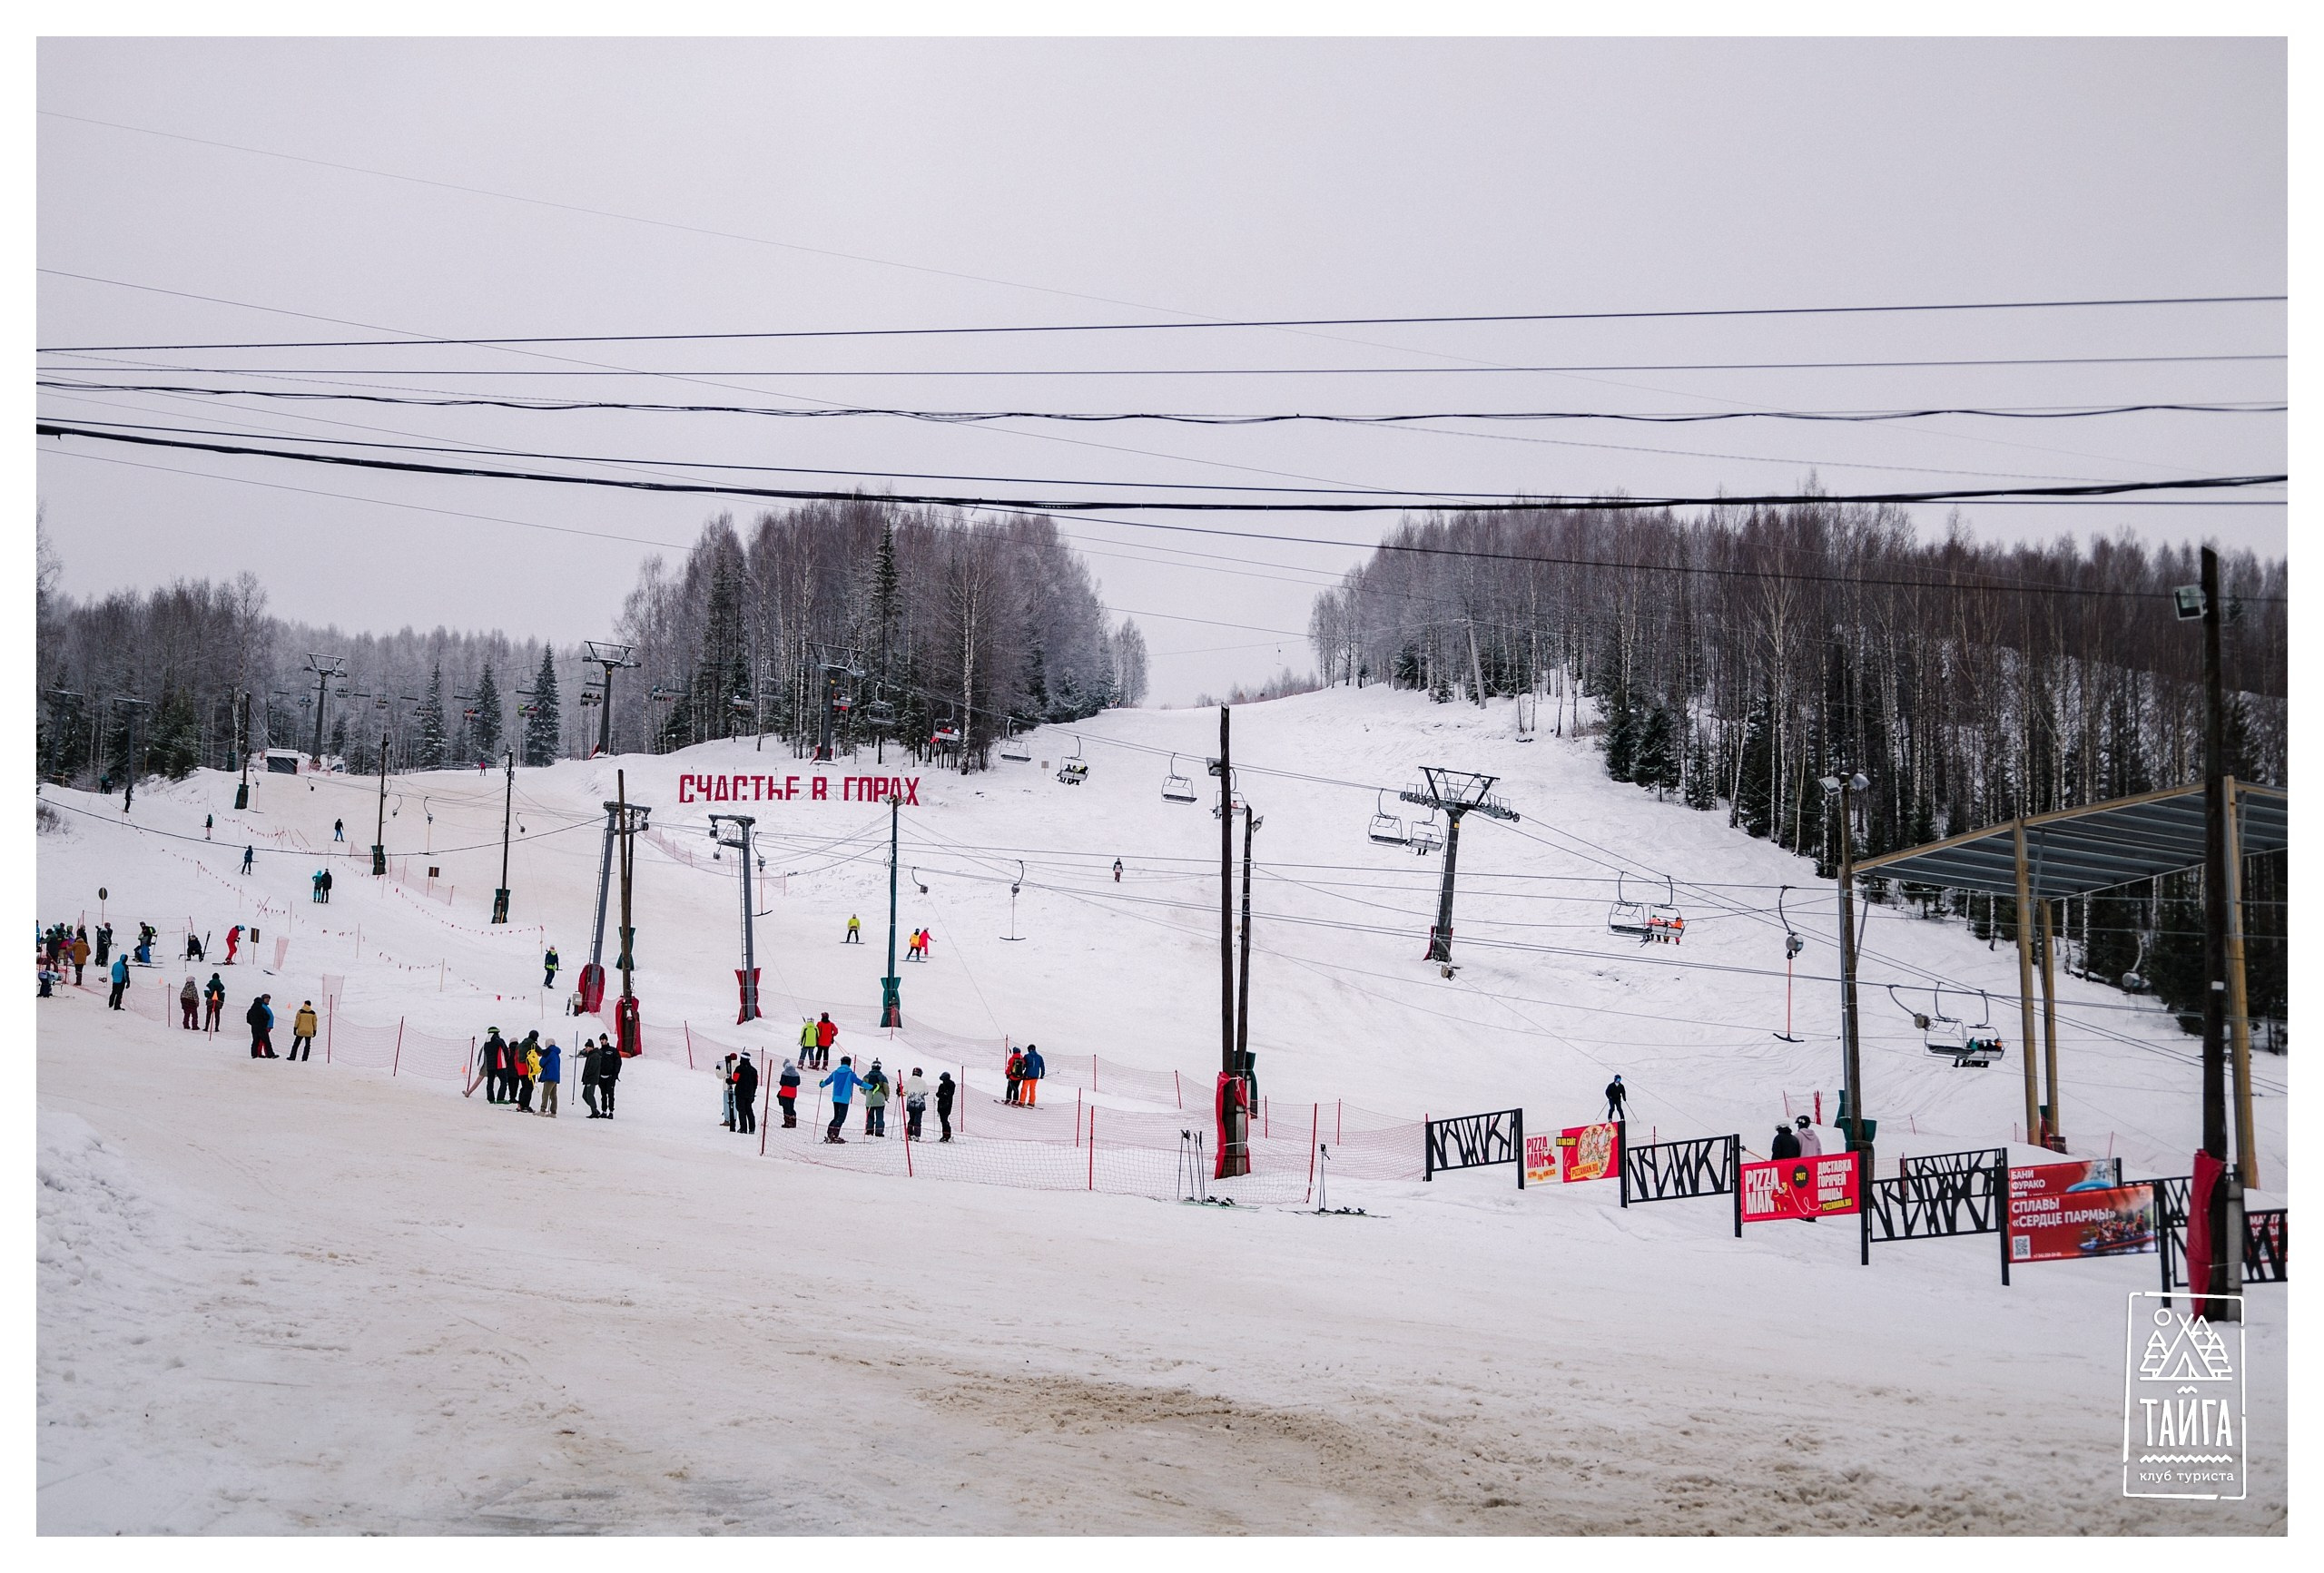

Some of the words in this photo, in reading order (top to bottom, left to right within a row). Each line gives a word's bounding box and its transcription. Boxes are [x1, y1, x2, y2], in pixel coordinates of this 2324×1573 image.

[679, 774, 800, 802] СЧАСТЬЕ
[844, 776, 920, 806] ГОРАХ
[1526, 1136, 1548, 1154] PIZZA
[1527, 1152, 1545, 1169] MAN
[1817, 1159, 1853, 1175] ДОСТАВКА
[1745, 1167, 1779, 1193] PIZZA
[1817, 1172, 1846, 1188] ГОРЯЧЕЙ
[2011, 1170, 2034, 1180] БАНИ
[2011, 1179, 2046, 1191] ФУРАКО
[1746, 1190, 1776, 1214] MAN
[2011, 1198, 2060, 1214] СПЛАВЫ
[2012, 1213, 2063, 1228] «СЕРДЦЕ
[2064, 1208, 2116, 1224] ПАРМЫ»
